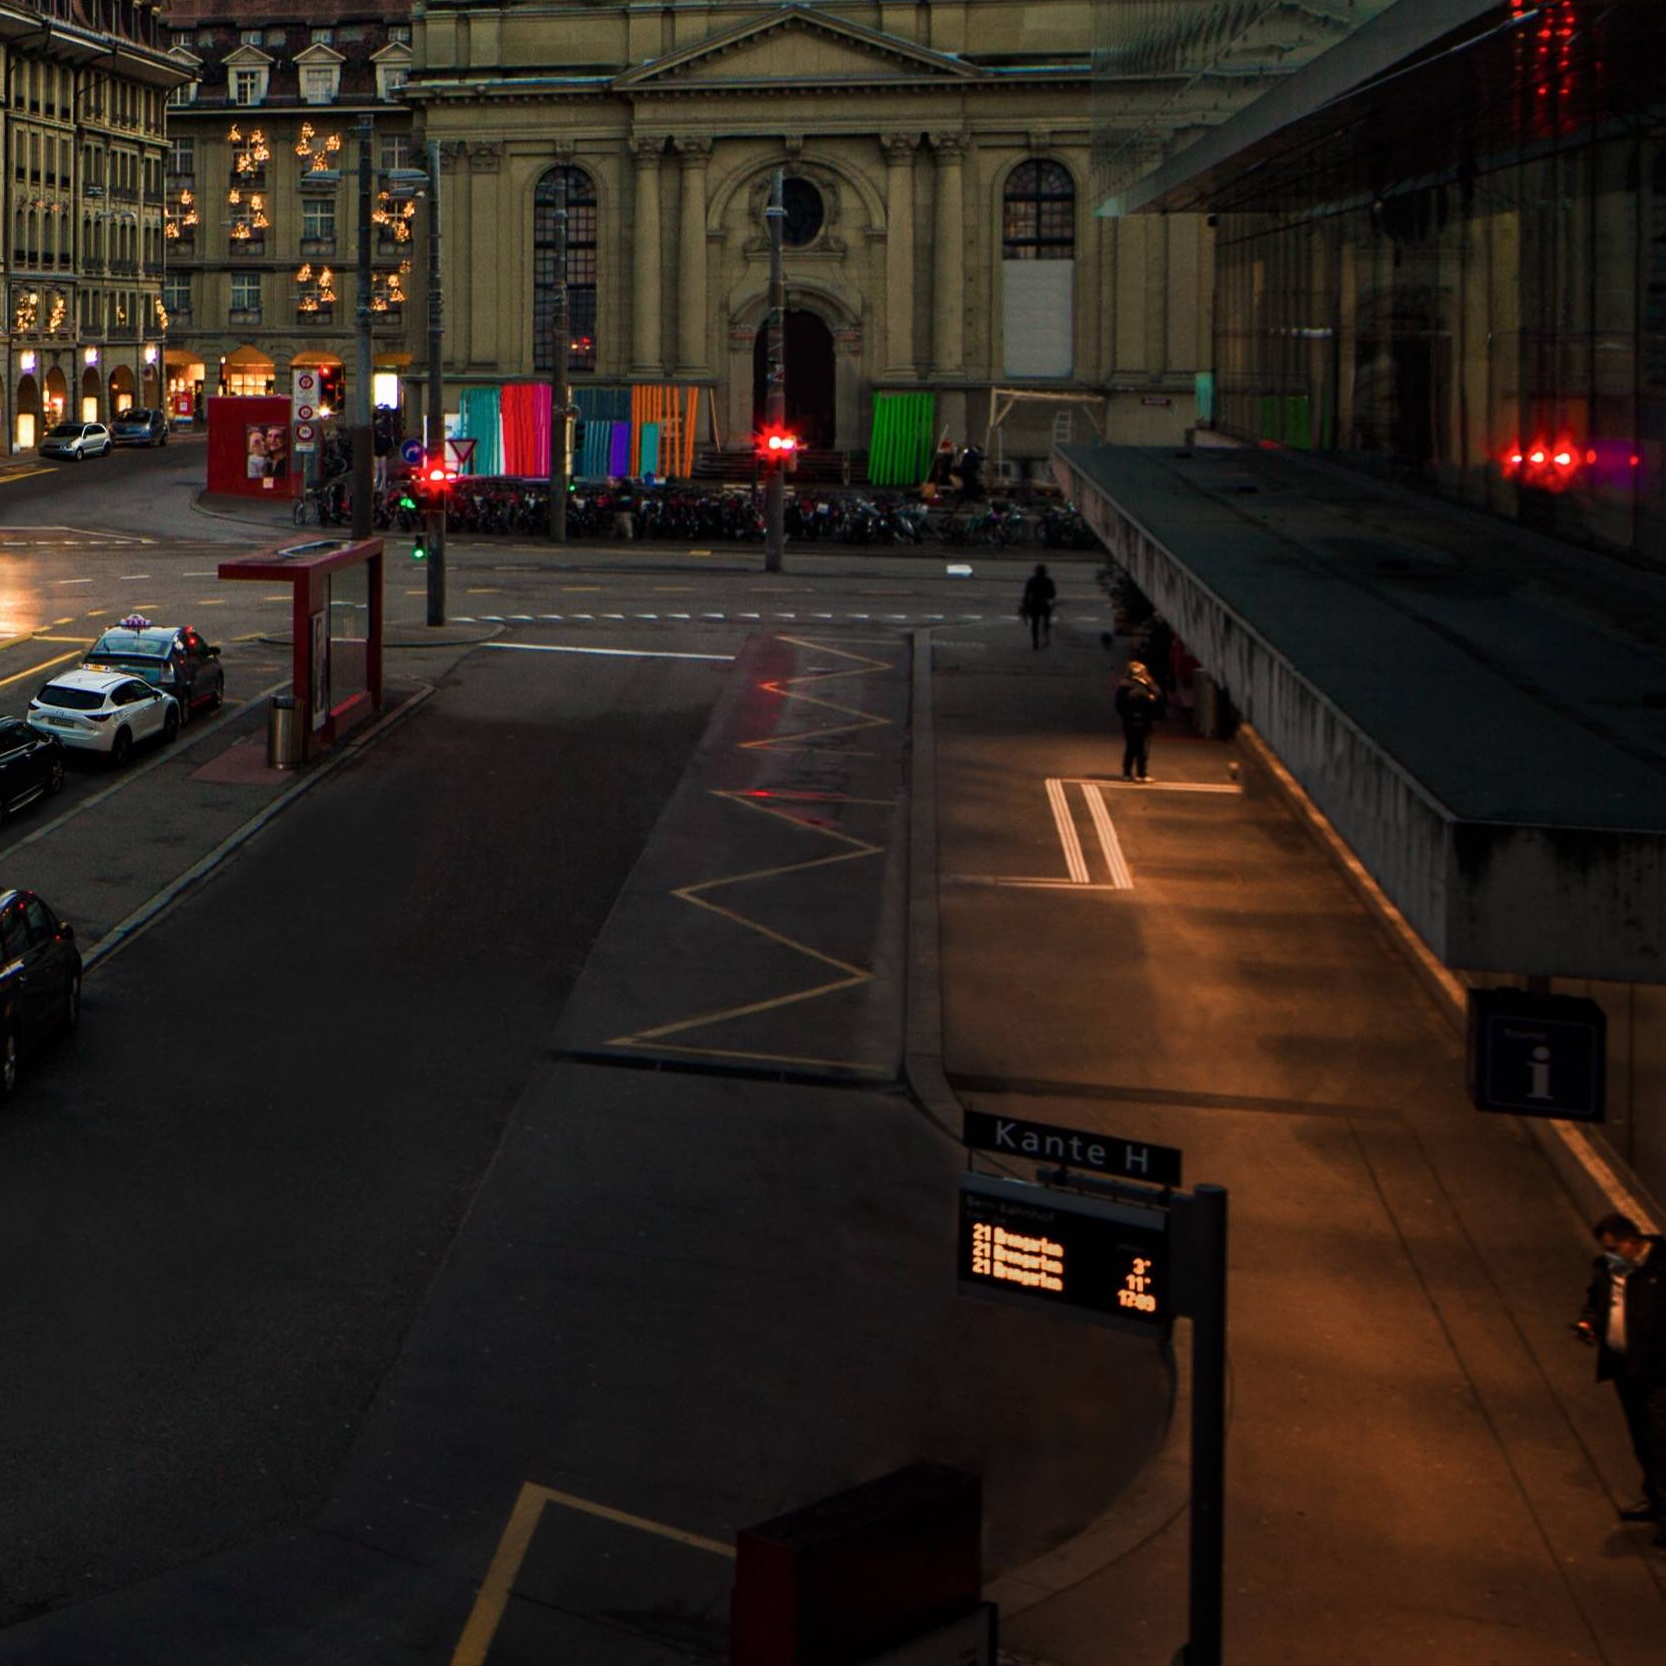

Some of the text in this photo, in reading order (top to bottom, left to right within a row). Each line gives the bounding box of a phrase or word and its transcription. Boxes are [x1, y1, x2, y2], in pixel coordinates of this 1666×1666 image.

[994, 1119, 1149, 1173] Kante H
[972, 1222, 991, 1241] 21
[972, 1240, 991, 1258] 21
[972, 1257, 991, 1275] 21
